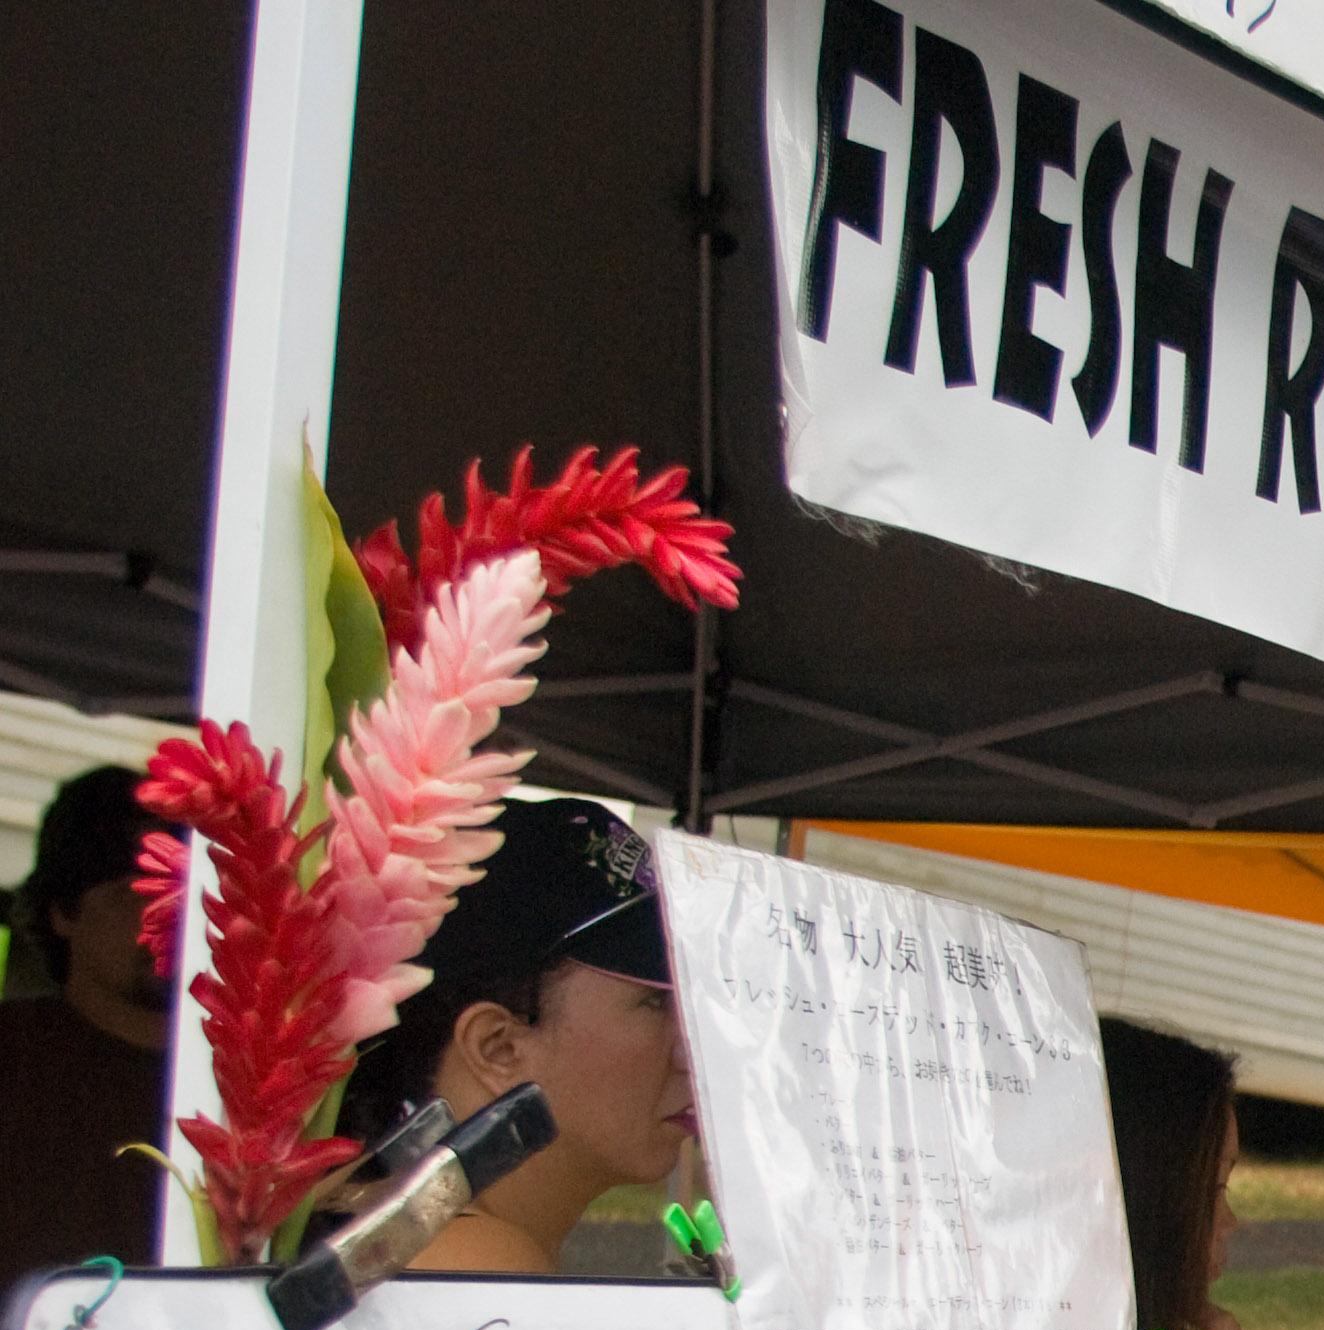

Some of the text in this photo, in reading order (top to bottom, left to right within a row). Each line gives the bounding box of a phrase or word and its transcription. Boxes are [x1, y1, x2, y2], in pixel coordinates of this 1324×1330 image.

[798, 0, 1236, 475] FRESH
[843, 920, 918, 974] 大人気
